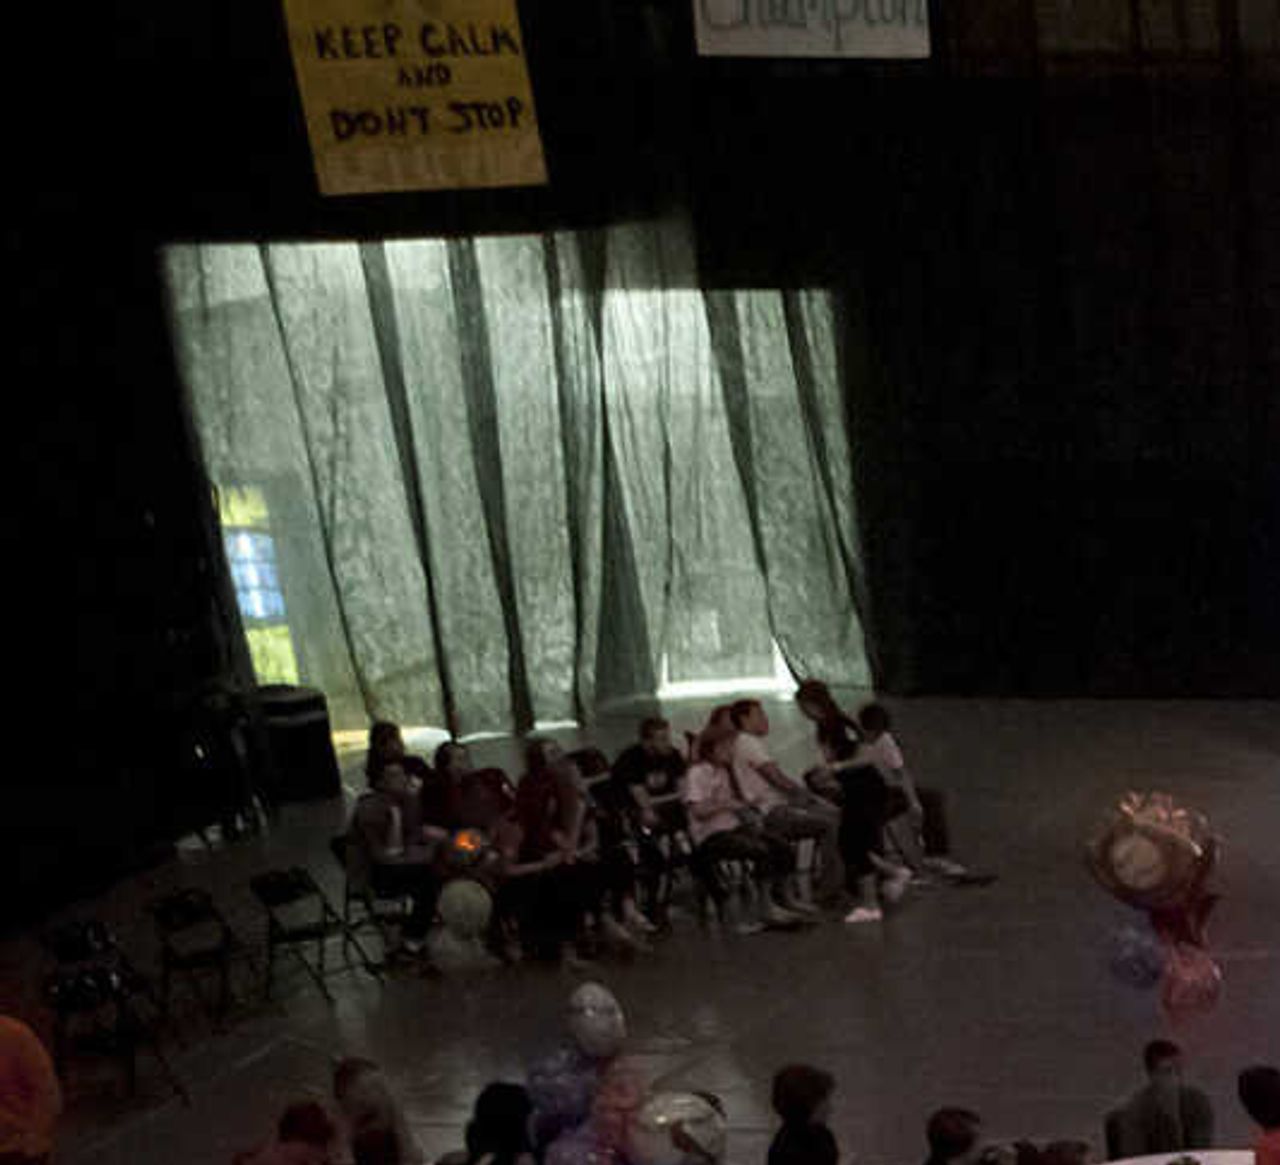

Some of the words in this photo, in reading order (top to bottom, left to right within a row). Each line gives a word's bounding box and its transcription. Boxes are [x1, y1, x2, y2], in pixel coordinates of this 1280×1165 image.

[314, 24, 400, 58] KEEP
[420, 22, 520, 57] CALM
[398, 63, 451, 87] AND
[445, 96, 522, 133] STOP
